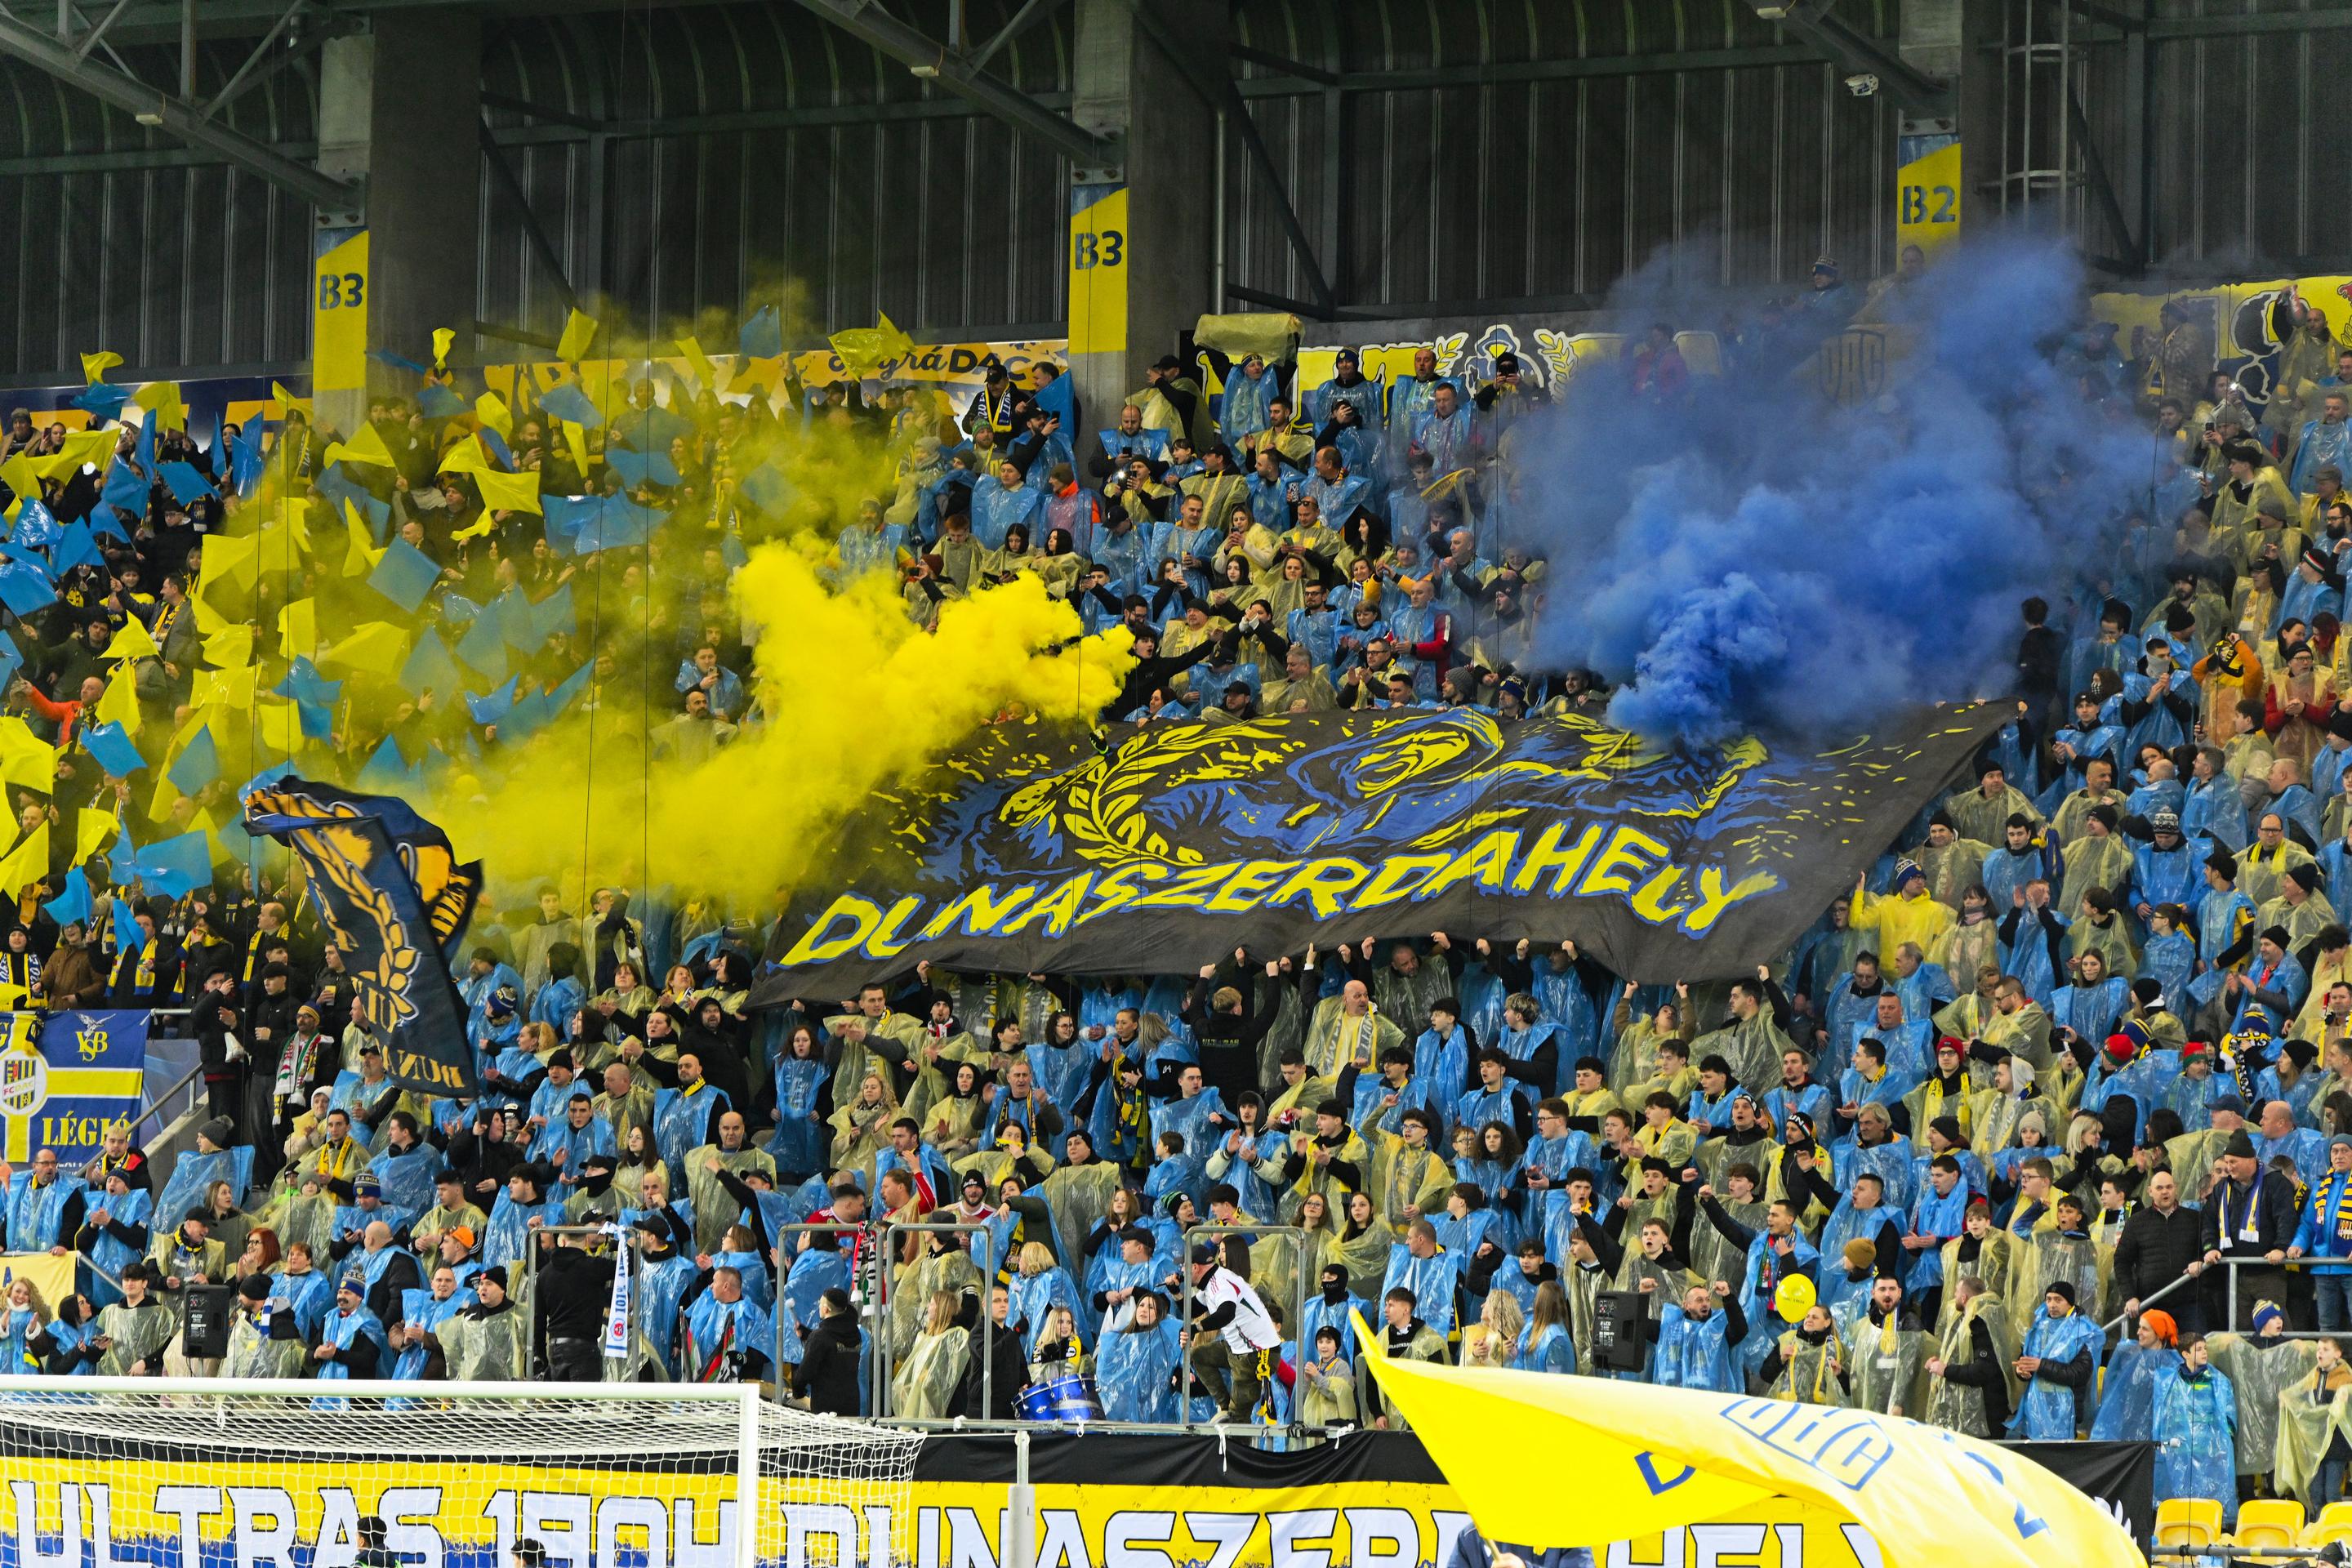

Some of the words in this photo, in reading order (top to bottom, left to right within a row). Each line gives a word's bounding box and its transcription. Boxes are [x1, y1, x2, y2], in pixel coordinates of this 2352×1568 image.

[1903, 185, 1955, 224] B2
[1076, 230, 1123, 270] B3
[320, 273, 363, 310] B3
[949, 349, 1031, 381] DAC
[766, 816, 1788, 972] DUNASZERDAHELY
[10, 1481, 443, 1568] ULTRAS
[483, 1490, 739, 1568] 1904
